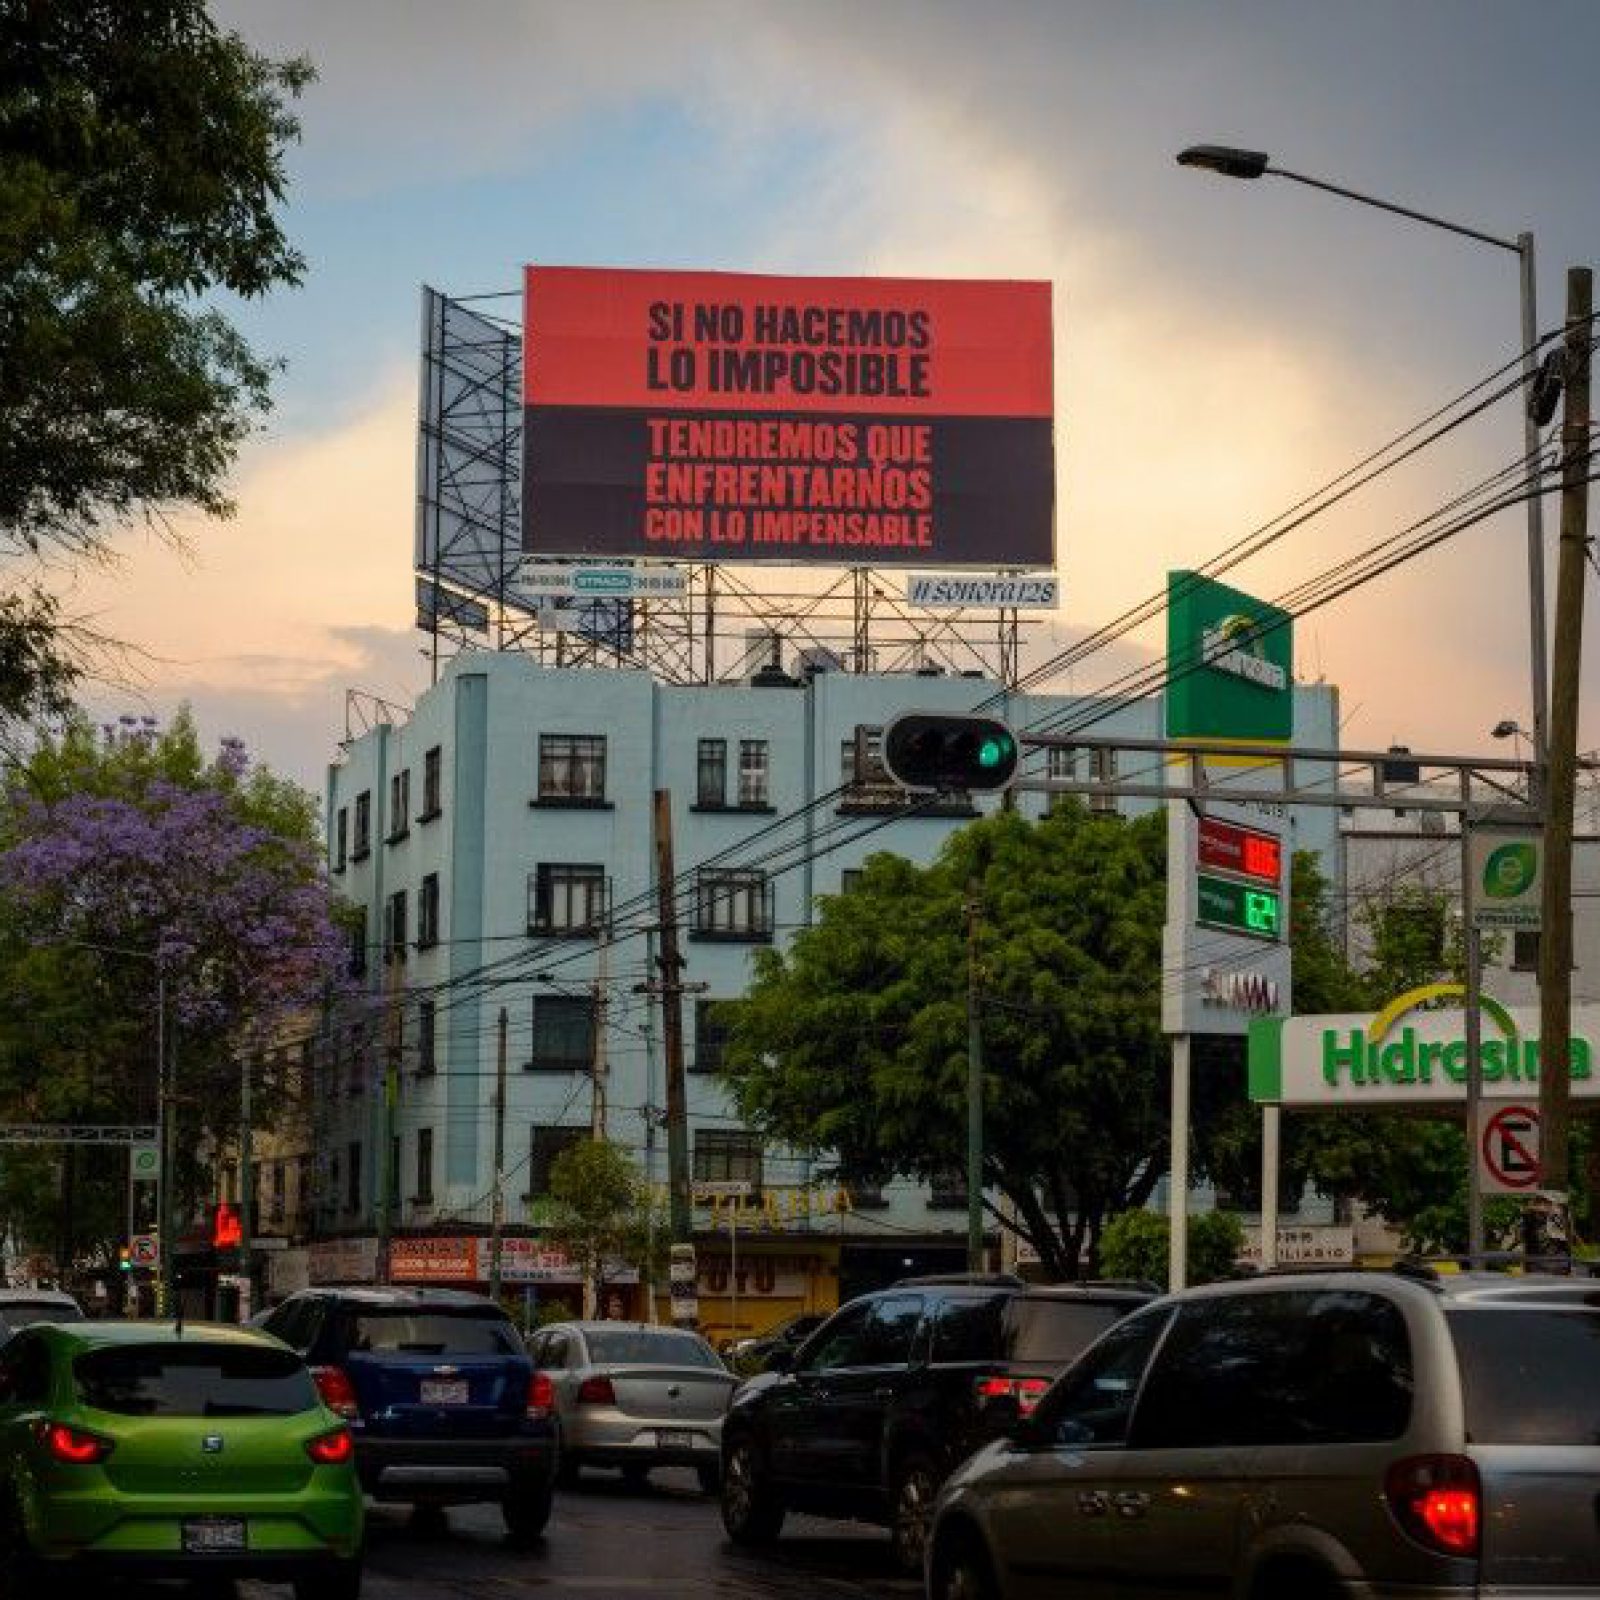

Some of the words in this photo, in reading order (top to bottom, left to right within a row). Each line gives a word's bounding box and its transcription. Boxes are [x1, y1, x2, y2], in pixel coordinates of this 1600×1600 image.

[648, 301, 684, 341] SI
[694, 305, 744, 342] NO
[755, 306, 931, 349] HACEMOS
[646, 347, 696, 391] LO
[708, 349, 930, 397] IMPOSIBLE
[646, 417, 858, 462] TENDREMOS
[867, 424, 932, 469] QUE
[646, 462, 931, 510] ENFRENTARNOS
[646, 508, 704, 541] CON
[710, 510, 746, 542] LO
[752, 511, 933, 547] IMPENSABLE
